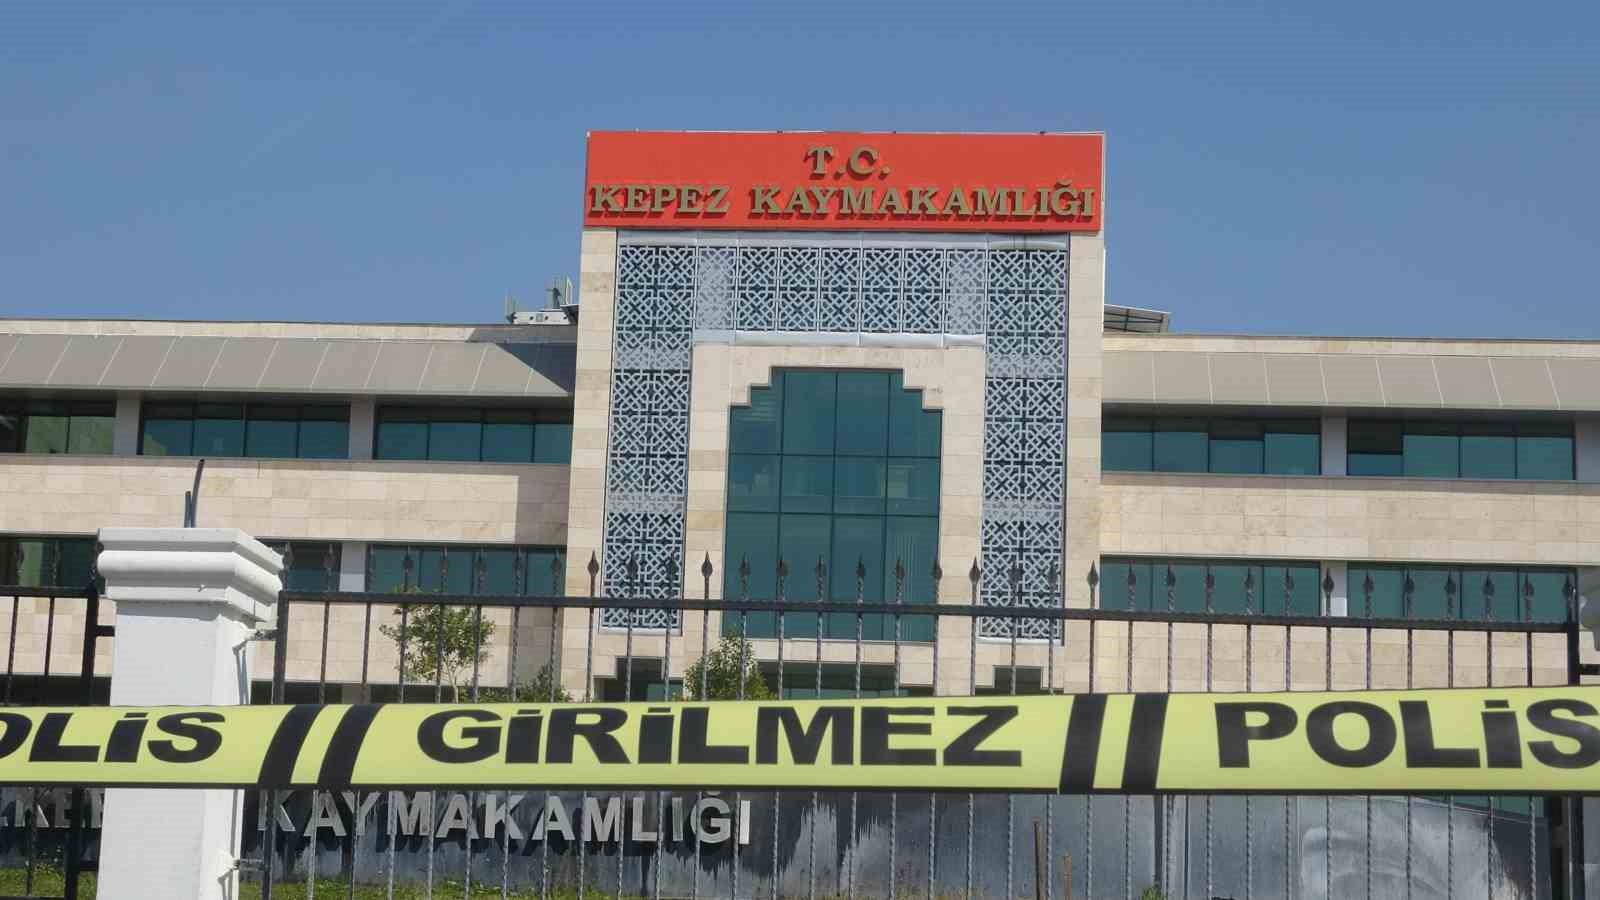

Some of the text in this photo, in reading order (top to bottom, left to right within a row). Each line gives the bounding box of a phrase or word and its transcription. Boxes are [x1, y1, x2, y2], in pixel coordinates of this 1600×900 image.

[805, 146, 890, 177] T.C.
[589, 179, 1095, 218] KEPEZ KAYMAKAMLIĞI
[257, 786, 751, 844] KAYMAKAMLIĞI
